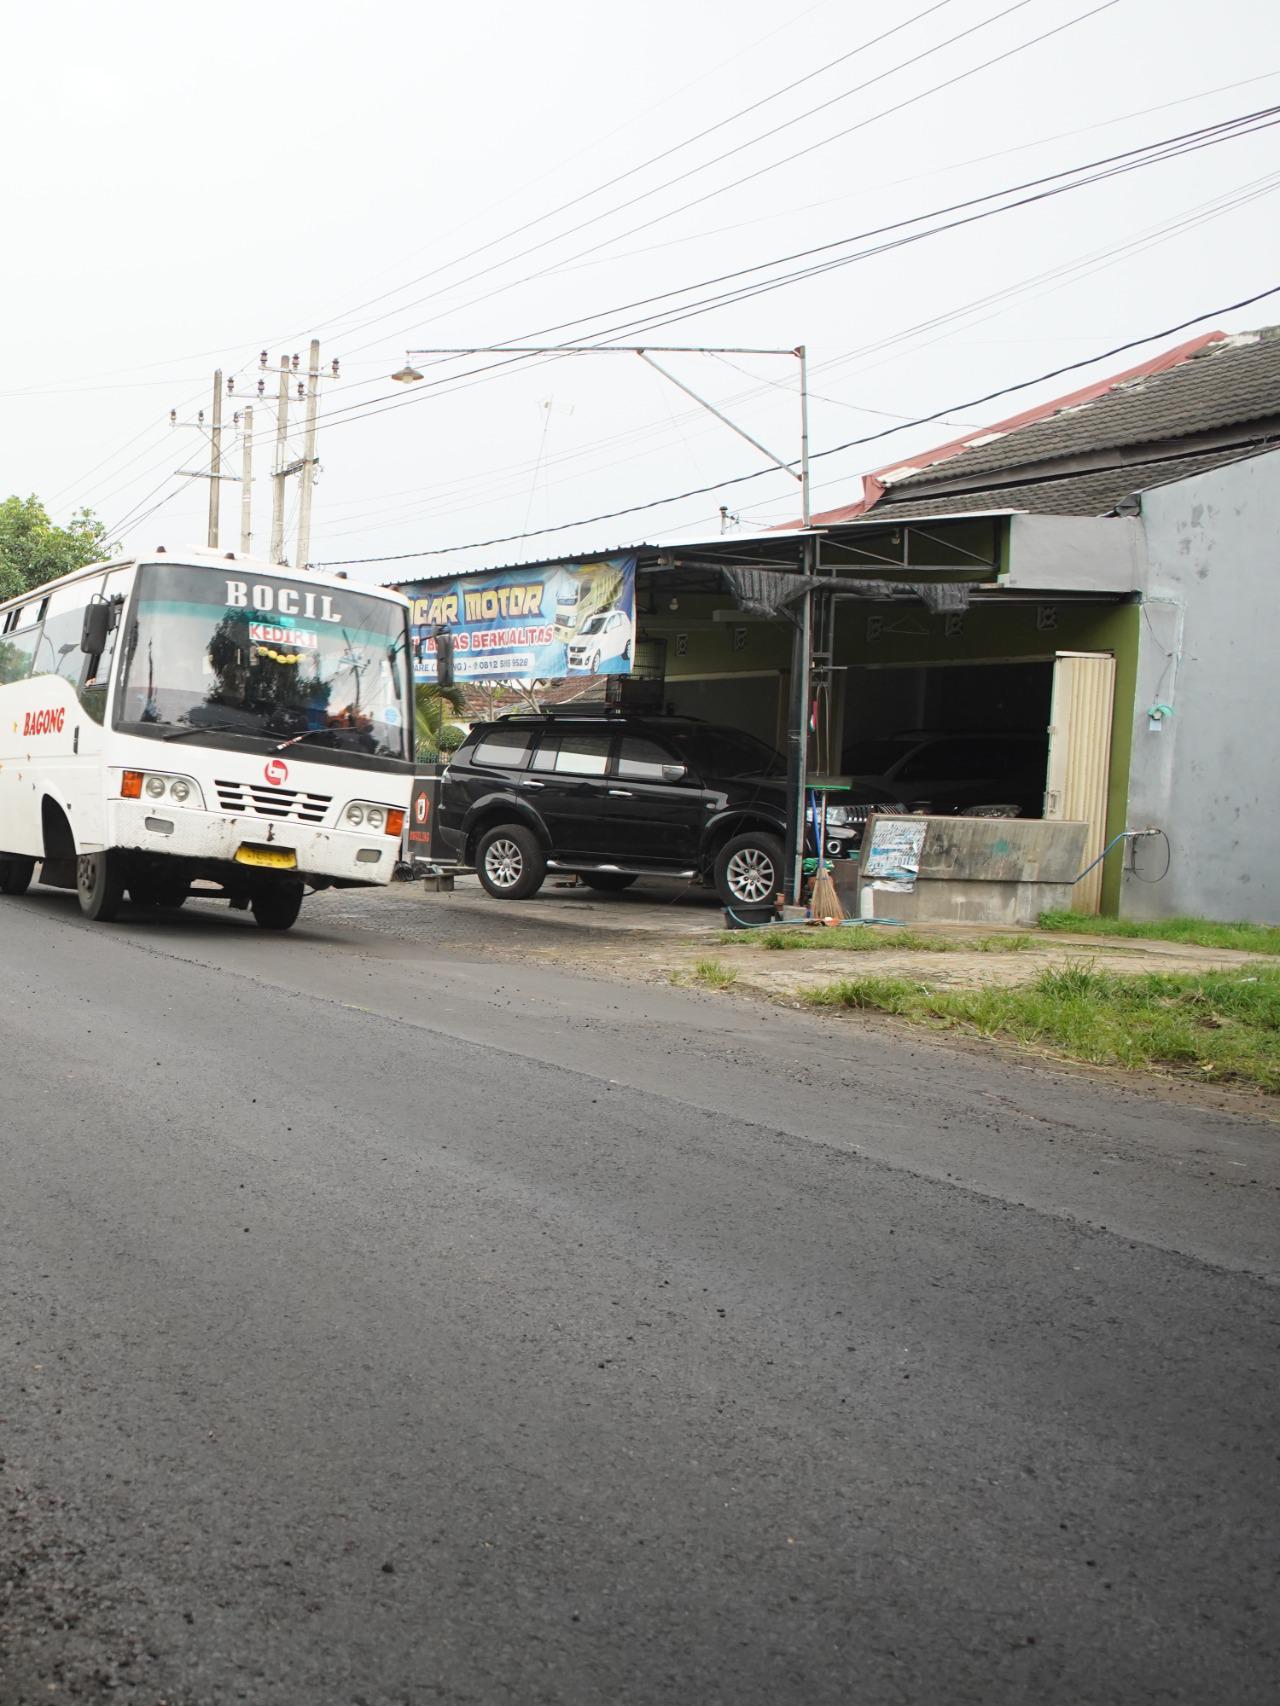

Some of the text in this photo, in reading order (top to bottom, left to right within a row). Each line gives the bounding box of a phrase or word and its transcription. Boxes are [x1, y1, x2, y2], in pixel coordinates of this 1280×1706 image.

[225, 580, 342, 622] BOCIL
[465, 585, 544, 621] MOTOR
[250, 623, 316, 647] KEDIRI
[23, 707, 65, 736] BAGONG
